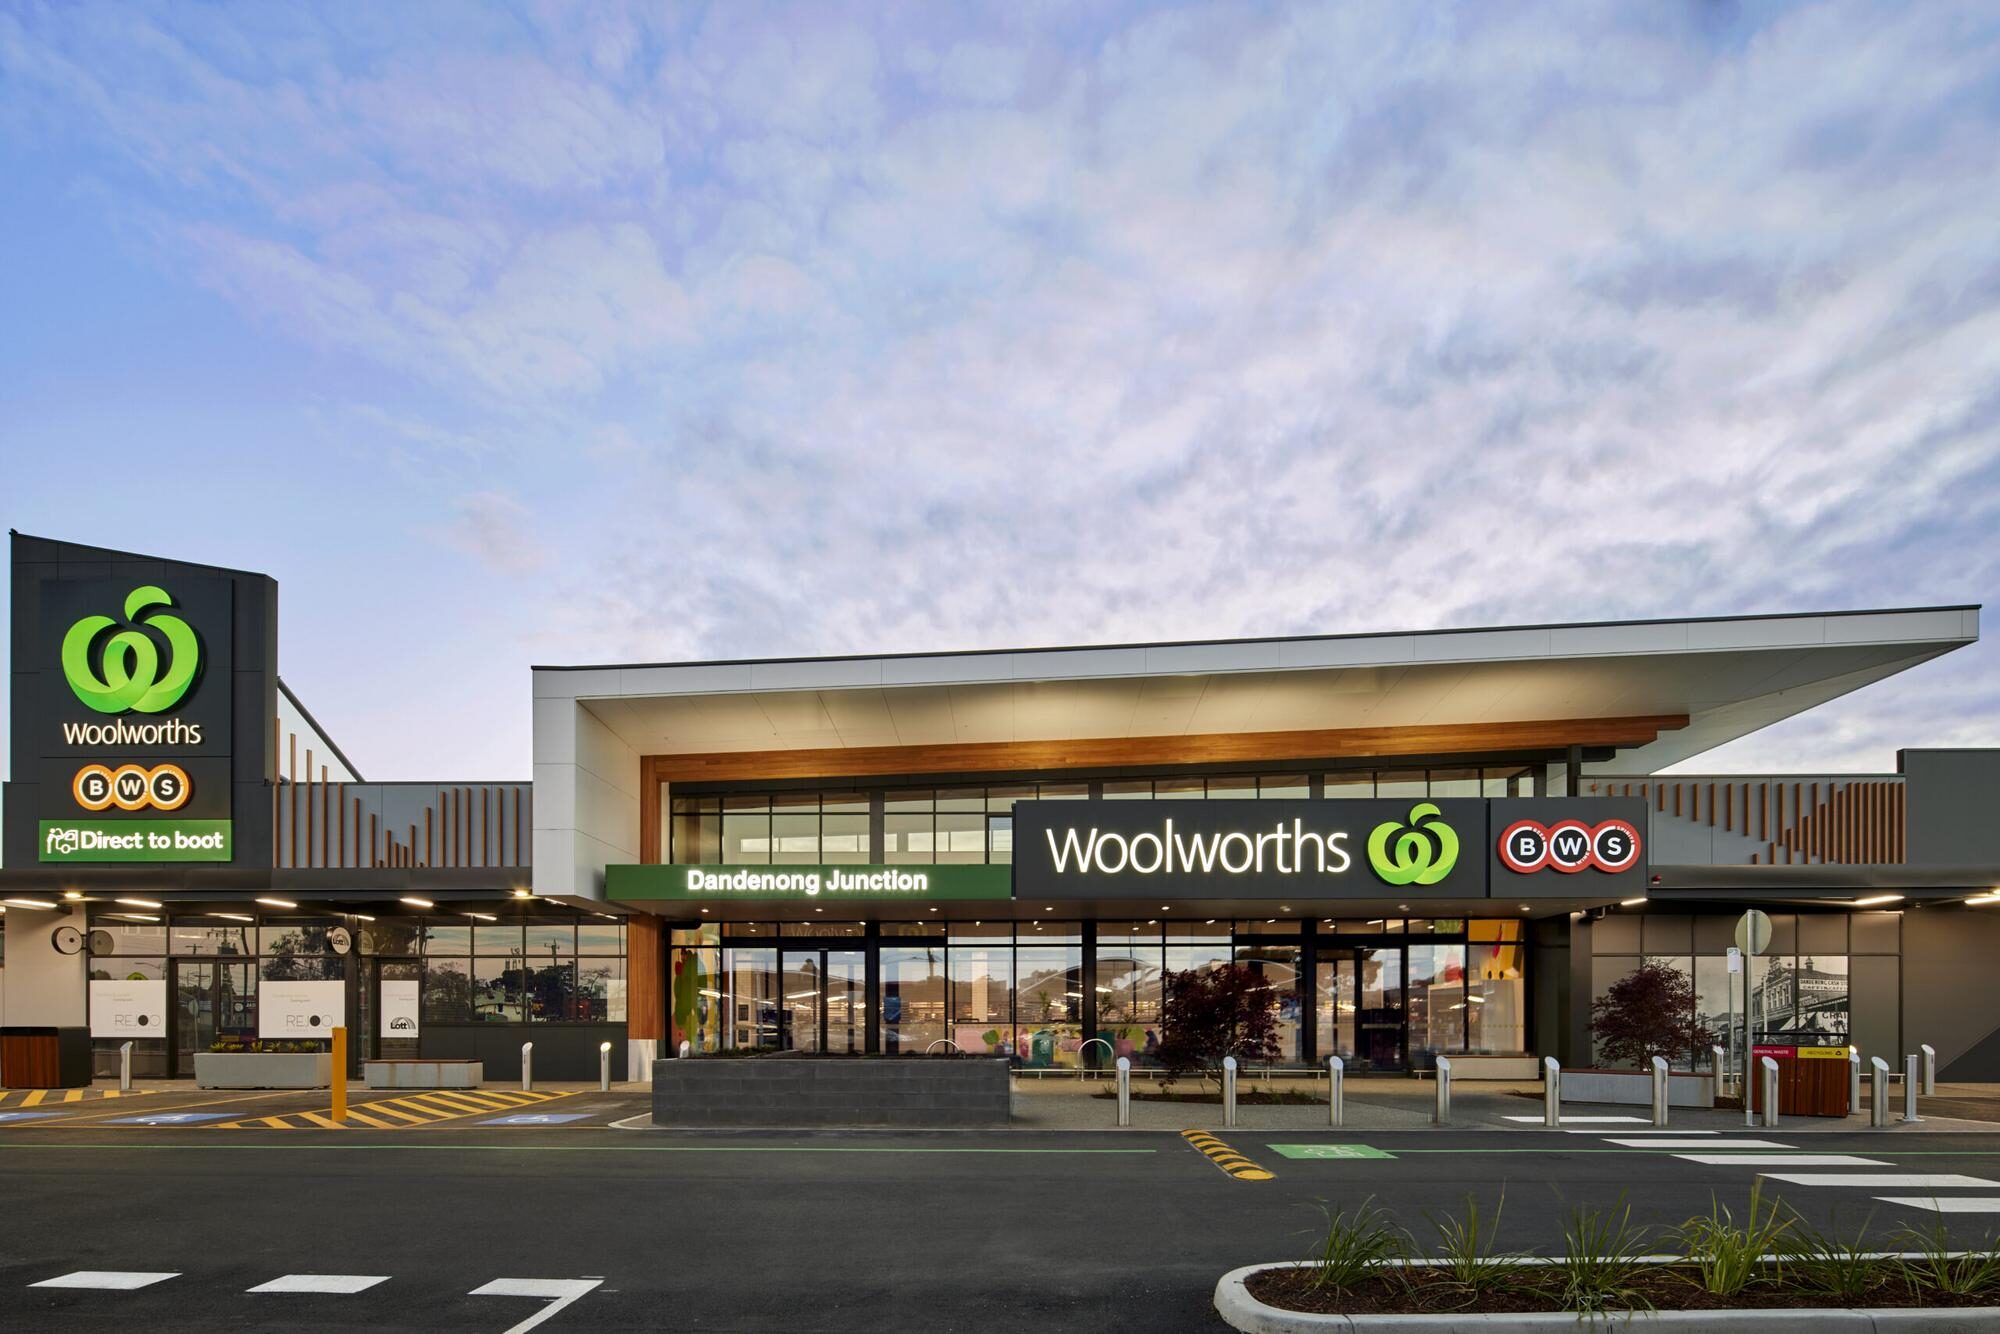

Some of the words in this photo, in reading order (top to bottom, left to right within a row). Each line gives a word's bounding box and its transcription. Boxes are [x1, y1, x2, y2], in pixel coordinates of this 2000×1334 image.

[63, 718, 202, 745] Woolworths
[81, 831, 144, 849] Direct
[148, 832, 171, 849] to
[174, 831, 224, 849] boot
[1046, 818, 1351, 873] Woolworths
[687, 870, 820, 895] Dandenong
[826, 870, 928, 890] Junction
[390, 1022, 408, 1030] Lott
